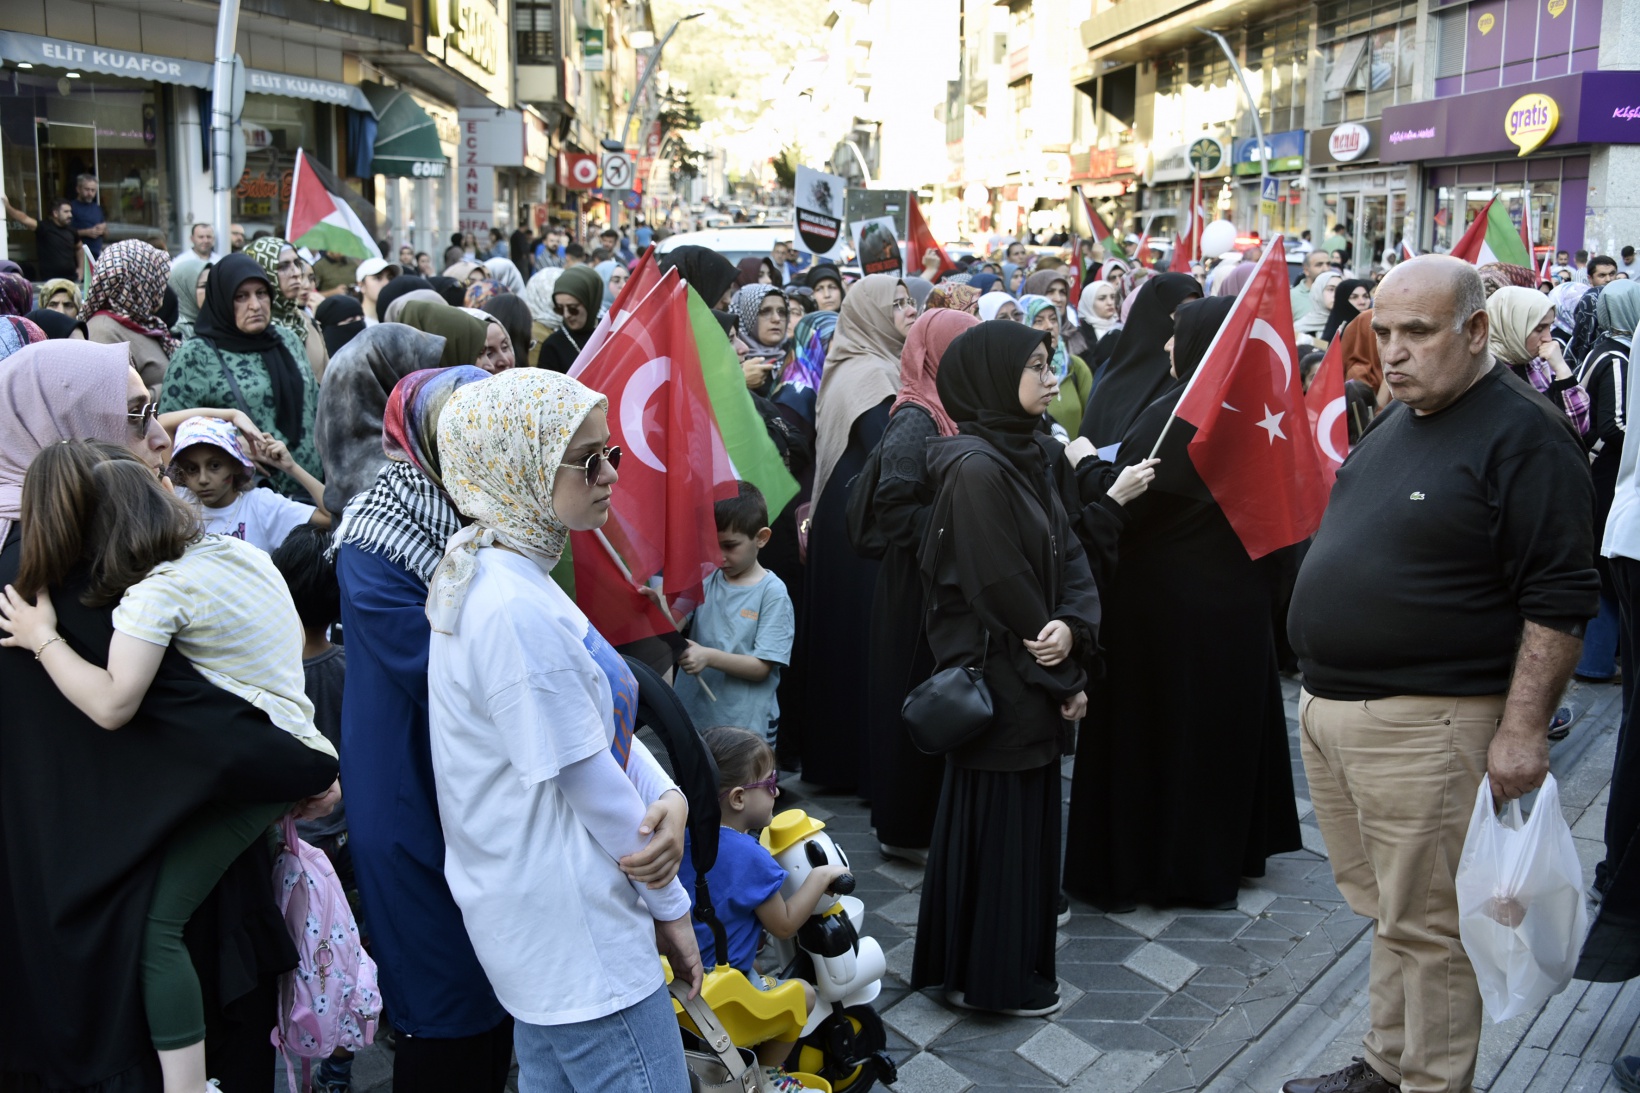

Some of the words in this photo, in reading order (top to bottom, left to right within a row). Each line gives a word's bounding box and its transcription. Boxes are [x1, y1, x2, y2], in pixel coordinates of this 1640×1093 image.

[42, 43, 86, 62] ELİT
[1510, 100, 1548, 136] gratis
[1333, 126, 1360, 154] mendy
[466, 120, 478, 210] ECZANE
